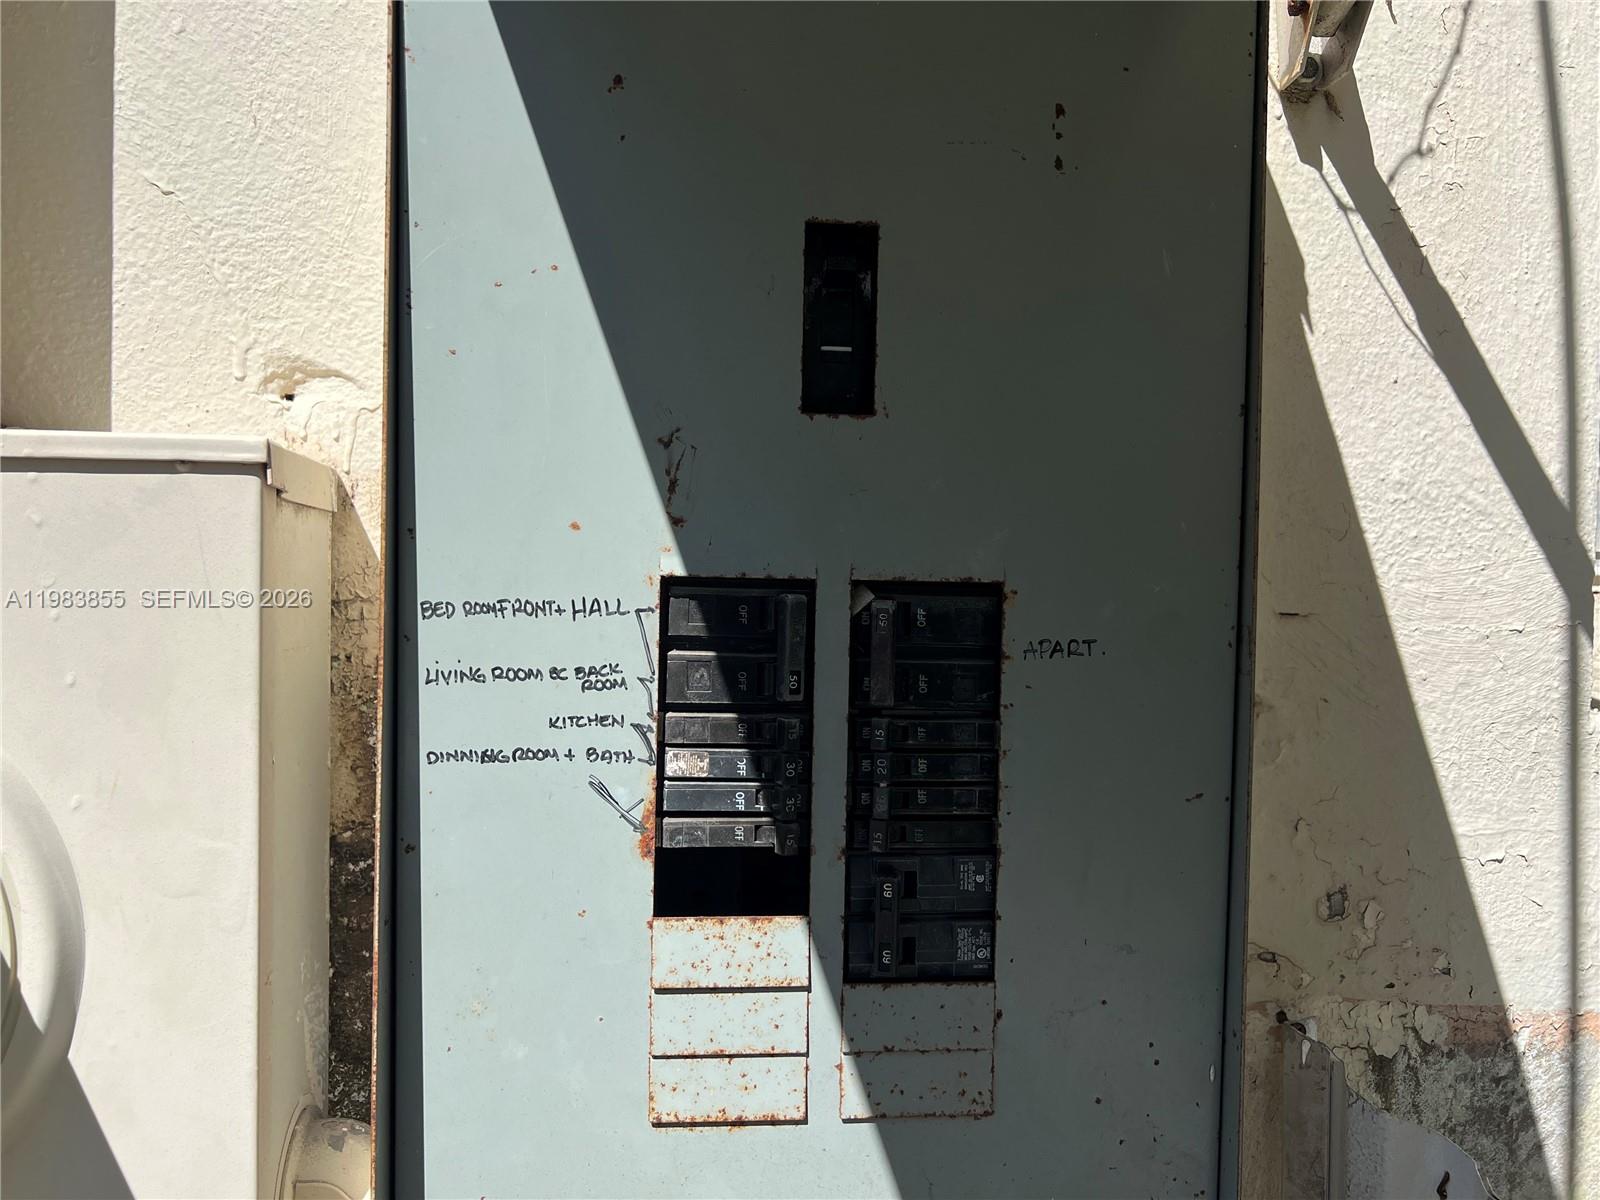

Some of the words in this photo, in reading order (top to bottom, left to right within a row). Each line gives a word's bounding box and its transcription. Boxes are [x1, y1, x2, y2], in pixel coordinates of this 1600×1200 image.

[420, 600, 456, 620] BED
[571, 597, 630, 622] HALL
[738, 604, 748, 625] OFF
[917, 607, 927, 628] OFF
[1023, 638, 1106, 661] APART.
[491, 667, 543, 682] ROOM
[574, 663, 623, 679] BACK
[581, 677, 628, 693] ROOM
[737, 671, 747, 693] OFF
[789, 674, 798, 689] 50
[918, 673, 928, 694] OFF
[549, 713, 625, 730] KITCHEN
[738, 723, 748, 737] OFF
[875, 728, 885, 741] 15
[917, 726, 928, 742] OFF
[512, 747, 559, 762] ROOM
[586, 748, 636, 764] BATH
[736, 757, 747, 777] OFF
[785, 761, 796, 777] 30
[861, 759, 873, 772] ON
[876, 758, 887, 775] 20
[918, 757, 928, 774] OFF
[735, 791, 745, 811] OFF
[861, 792, 872, 806] ON
[917, 788, 928, 805] OFF
[734, 826, 744, 841] OFF
[883, 883, 892, 898] 60
[882, 949, 892, 965] 60
